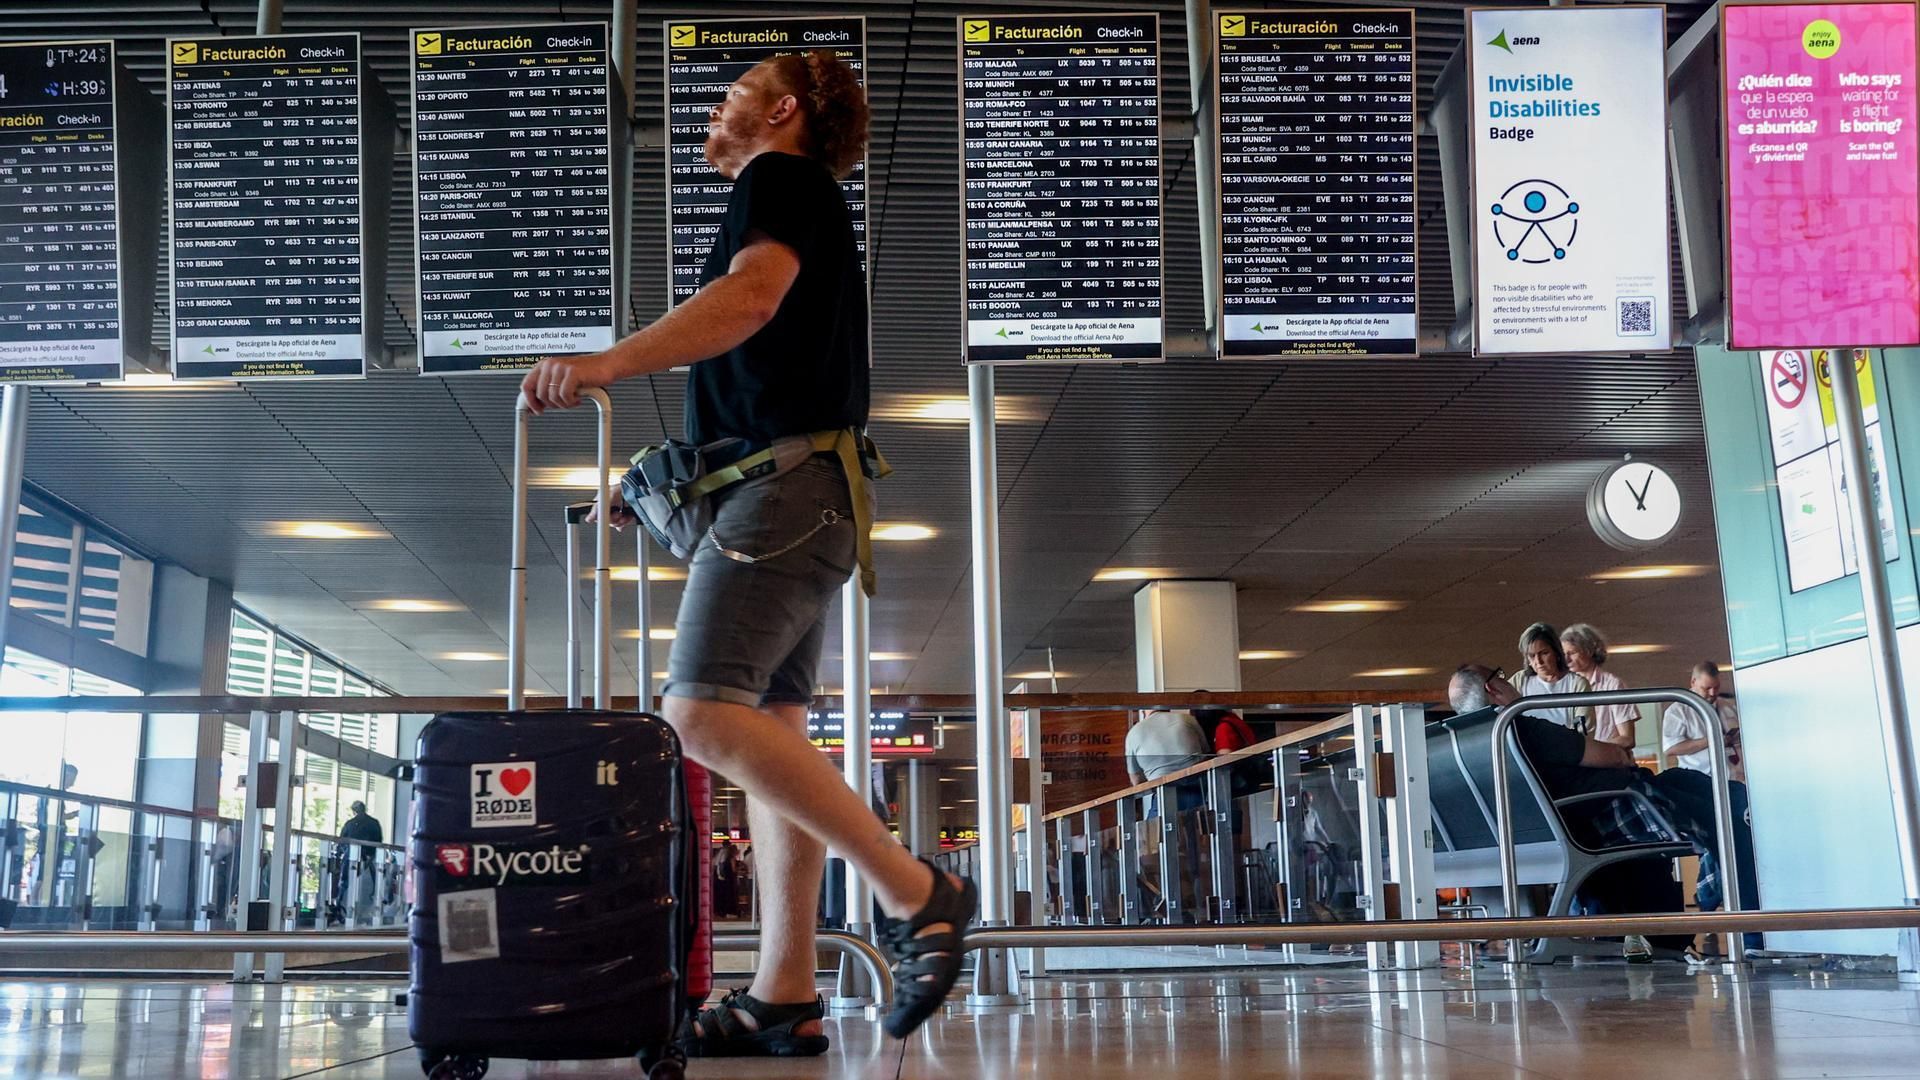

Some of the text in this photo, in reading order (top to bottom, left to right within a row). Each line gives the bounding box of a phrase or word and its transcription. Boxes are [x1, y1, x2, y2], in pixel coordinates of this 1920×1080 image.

[996, 25, 1143, 39] Facturación Check-in
[1251, 21, 1398, 34] Facturación Check-in
[702, 30, 849, 44] Facturación Check-in
[1513, 35, 1540, 46] aena
[1812, 31, 1831, 39] enjoy
[447, 36, 592, 51] Facturación Check-in
[1809, 39, 1834, 47] aena
[202, 47, 345, 61] Facturación Check-in
[63, 80, 98, 95] H:39
[1488, 75, 1573, 93] Invisible
[1738, 74, 1812, 90] ¿Quién dice
[1839, 74, 1901, 88] Who says
[1283, 94, 1305, 102] BAHÍA
[1741, 91, 1813, 105] que la espera
[1842, 89, 1899, 103] waiting for
[1489, 100, 1600, 118] Disabilities
[1747, 106, 1808, 119] de un vuelo
[1853, 104, 1889, 119] a flight
[58, 114, 100, 125] Check-in
[1738, 120, 1818, 134] es aburrida?
[1840, 119, 1902, 135] is boring?
[439, 132, 484, 140] LONDRES-ST
[1490, 127, 1534, 141] Badge
[1786, 143, 1794, 151] el
[1795, 143, 1808, 152] QR
[1849, 142, 1894, 151] Scan the QR
[1755, 155, 1761, 163] y
[1846, 152, 1897, 161] and have fun!
[440, 192, 482, 200] PARIS-ORLY
[994, 200, 1026, 208] CORUÑA
[441, 212, 476, 220] ISTANBUL
[441, 232, 484, 240] LANZAROTE
[1508, 284, 1528, 292] badge
[1548, 284, 1571, 292] people
[1522, 306, 1530, 314] by
[236, 340, 270, 348] Descárgate
[278, 340, 291, 348] App
[596, 760, 619, 785] it
[475, 769, 492, 797] I
[476, 799, 532, 814] RØDE
[473, 845, 582, 885] Rycote
